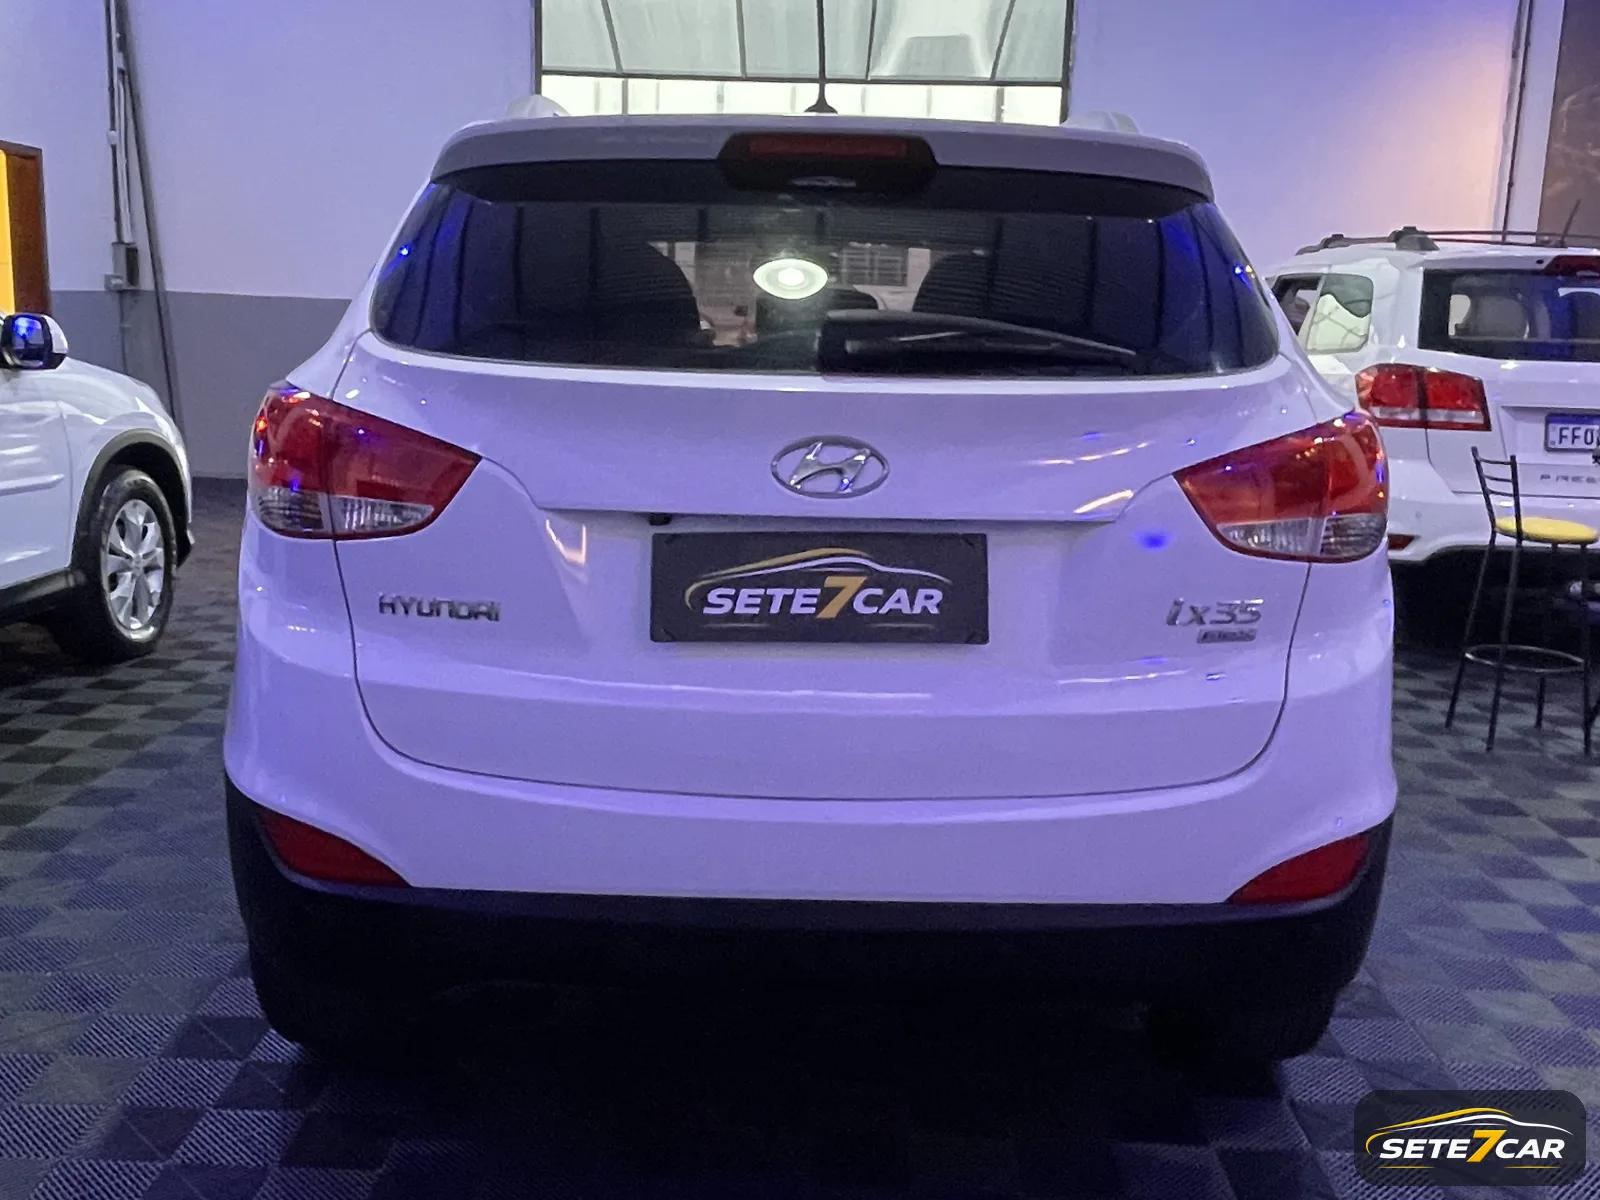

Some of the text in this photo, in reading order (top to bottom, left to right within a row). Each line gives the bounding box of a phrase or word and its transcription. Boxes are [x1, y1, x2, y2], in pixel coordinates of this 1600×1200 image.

[378, 593, 500, 622] HYUNDAI
[702, 575, 944, 619] SETE7CAR
[1165, 598, 1264, 626] ix35
